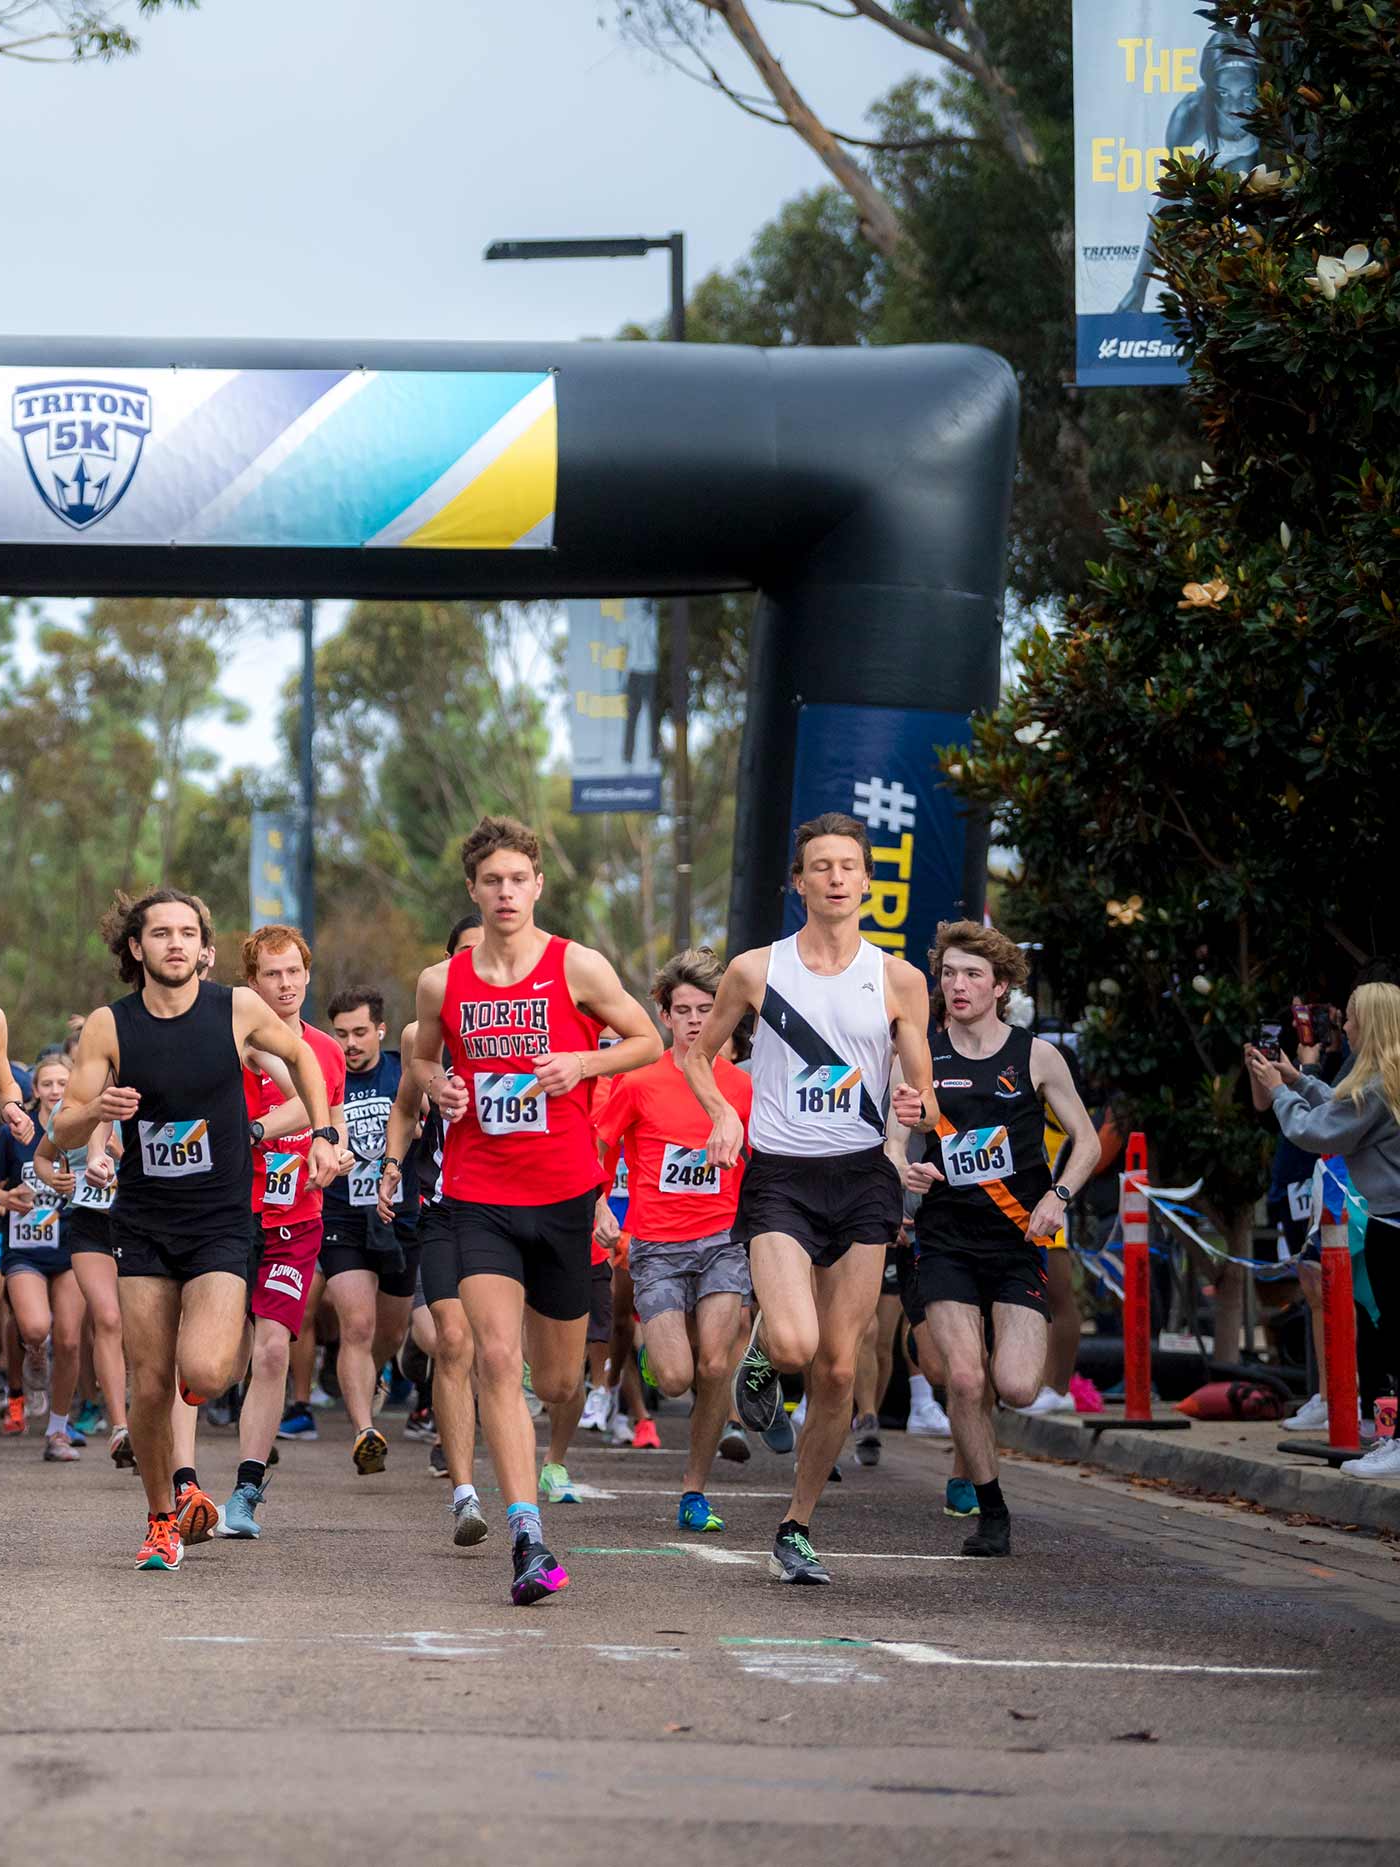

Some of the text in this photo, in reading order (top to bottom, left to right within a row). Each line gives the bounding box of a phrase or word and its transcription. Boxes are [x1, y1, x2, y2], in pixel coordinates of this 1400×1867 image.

[1117, 37, 1197, 93] THE
[1082, 245, 1140, 257] TRITONS
[18, 391, 145, 421] TRITON
[55, 419, 110, 452] 5K
[853, 776, 914, 960] #TRI
[460, 997, 550, 1037] NORTH
[463, 1033, 550, 1059] ANDOVER
[480, 1095, 539, 1124] 2193
[795, 1086, 852, 1113] 1814
[145, 1139, 204, 1167] 1269
[948, 1145, 1006, 1176] 1503
[665, 1162, 717, 1187] 2484
[14, 1223, 54, 1242] 1358
